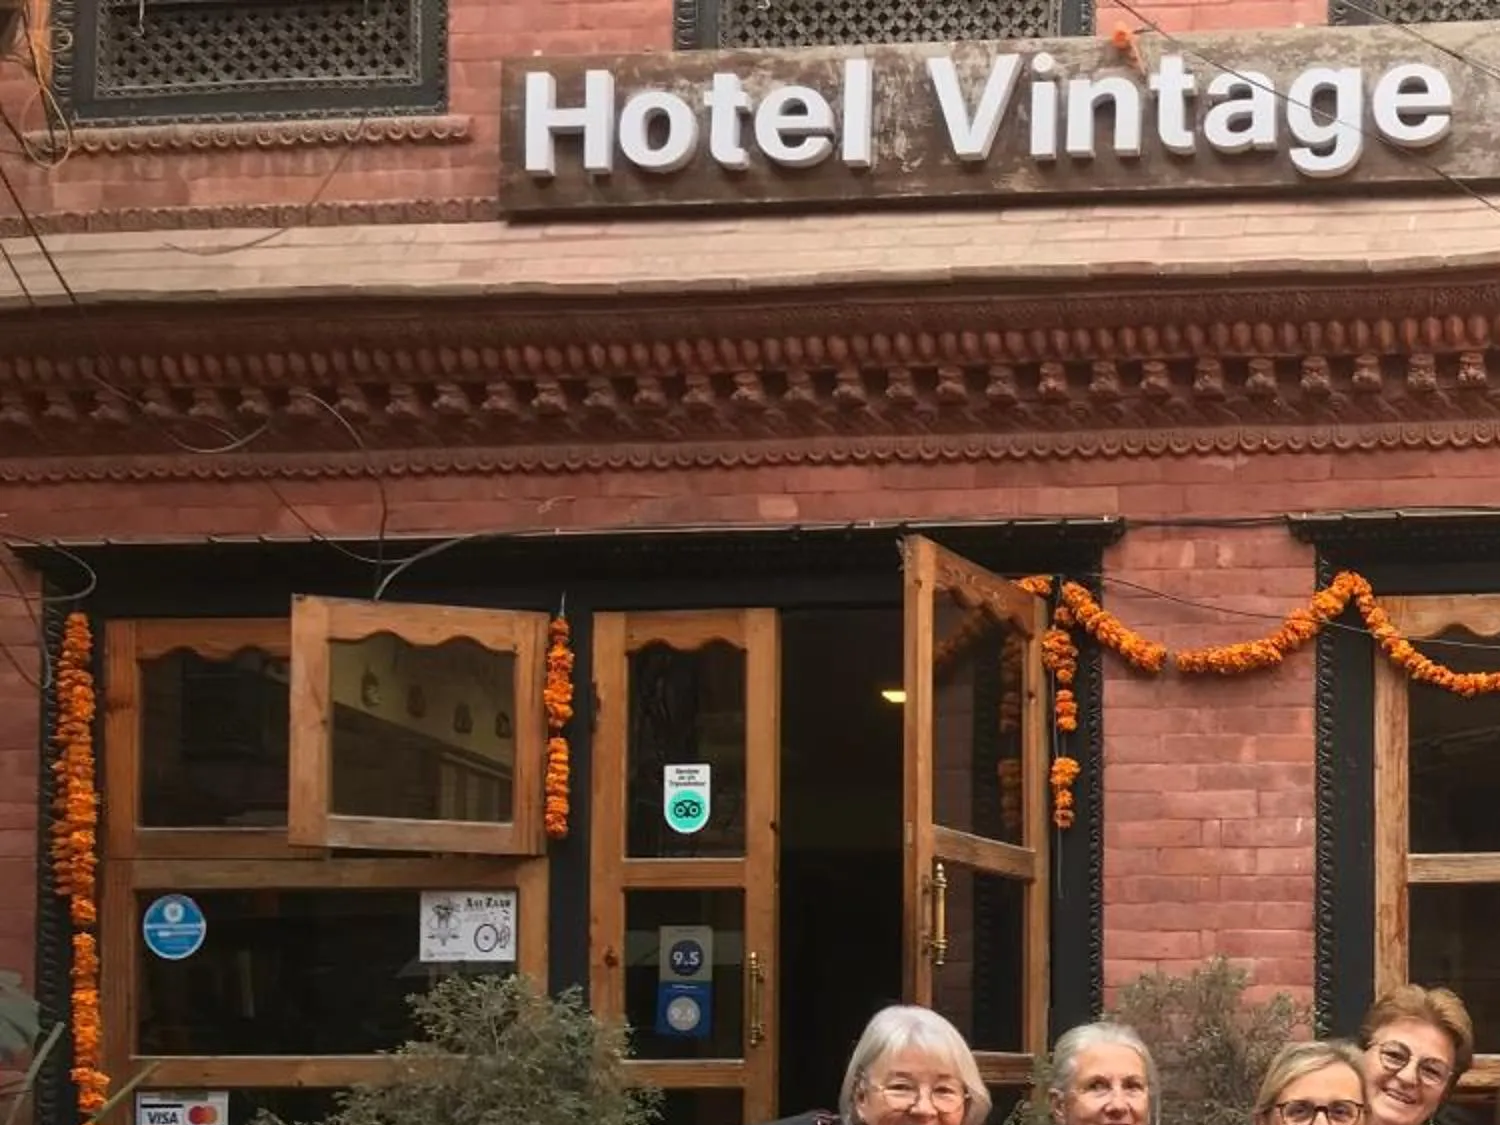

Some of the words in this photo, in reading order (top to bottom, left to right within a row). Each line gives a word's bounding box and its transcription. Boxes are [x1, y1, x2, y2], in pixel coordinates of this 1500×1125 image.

[525, 58, 874, 178] Hotel
[926, 51, 1453, 178] Vintage
[673, 951, 699, 965] 9.5
[147, 1111, 179, 1125] VISA
